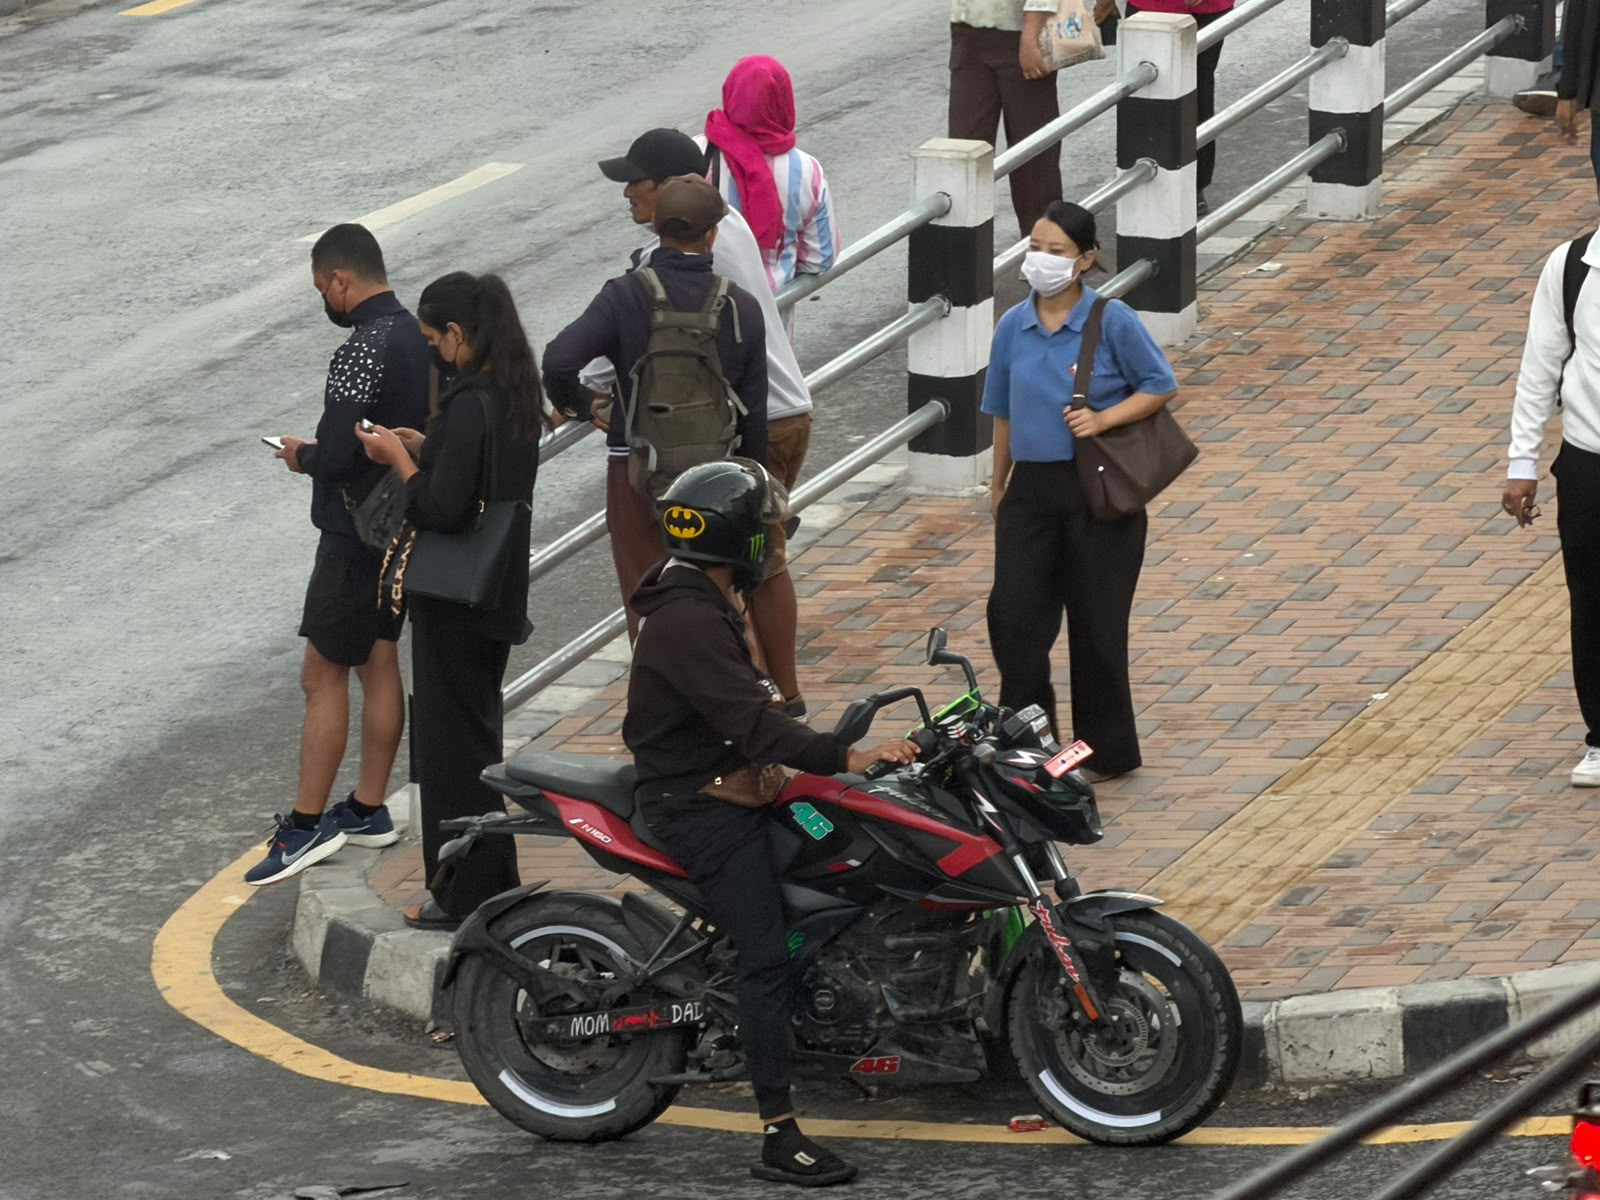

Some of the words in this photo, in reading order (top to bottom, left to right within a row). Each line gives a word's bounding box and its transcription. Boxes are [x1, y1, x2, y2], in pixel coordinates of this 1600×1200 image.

[789, 802, 834, 840] 46
[570, 1013, 610, 1037] MOM
[850, 1055, 901, 1075] 46
